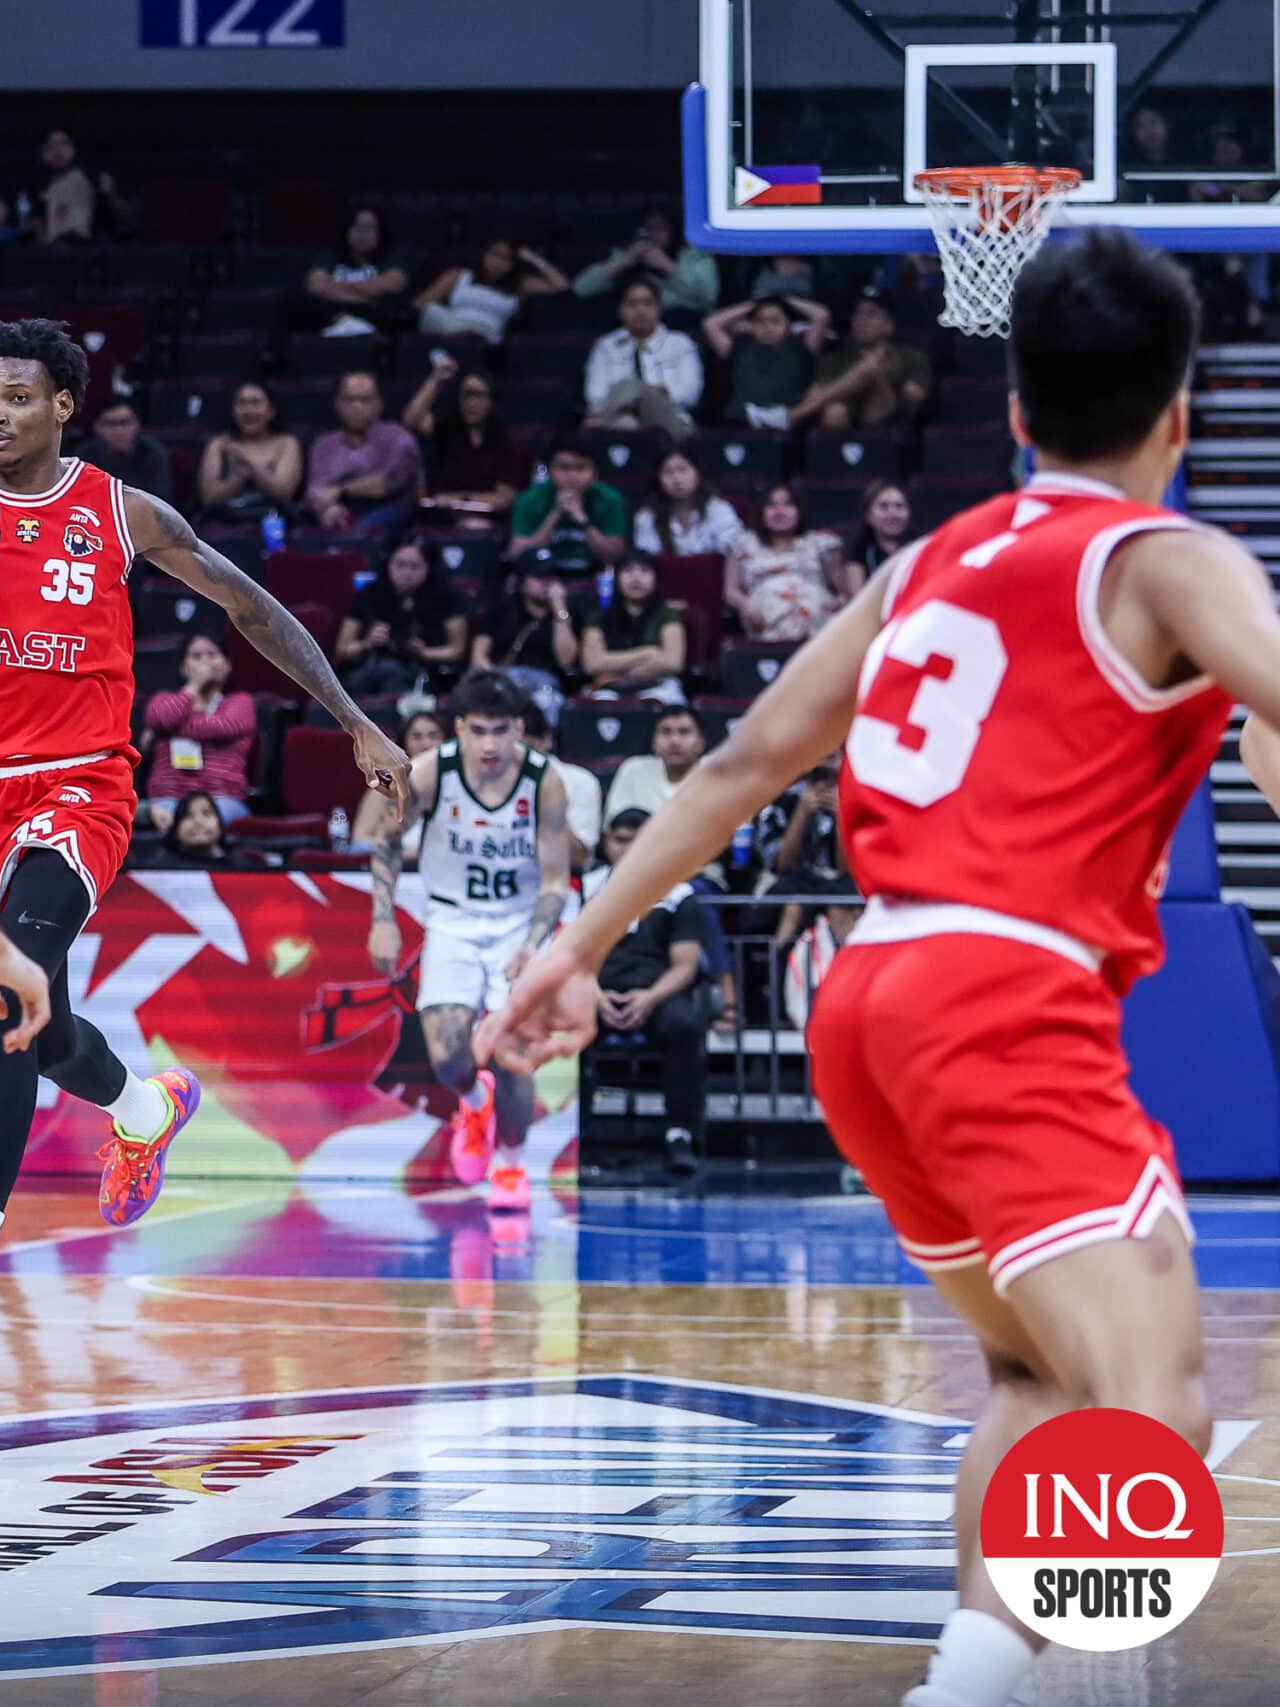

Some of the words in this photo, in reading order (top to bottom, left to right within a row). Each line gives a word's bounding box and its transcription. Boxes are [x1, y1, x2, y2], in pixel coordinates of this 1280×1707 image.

[40, 558, 97, 606] 35
[448, 829, 474, 854] La
[38, 1490, 198, 1516] OF
